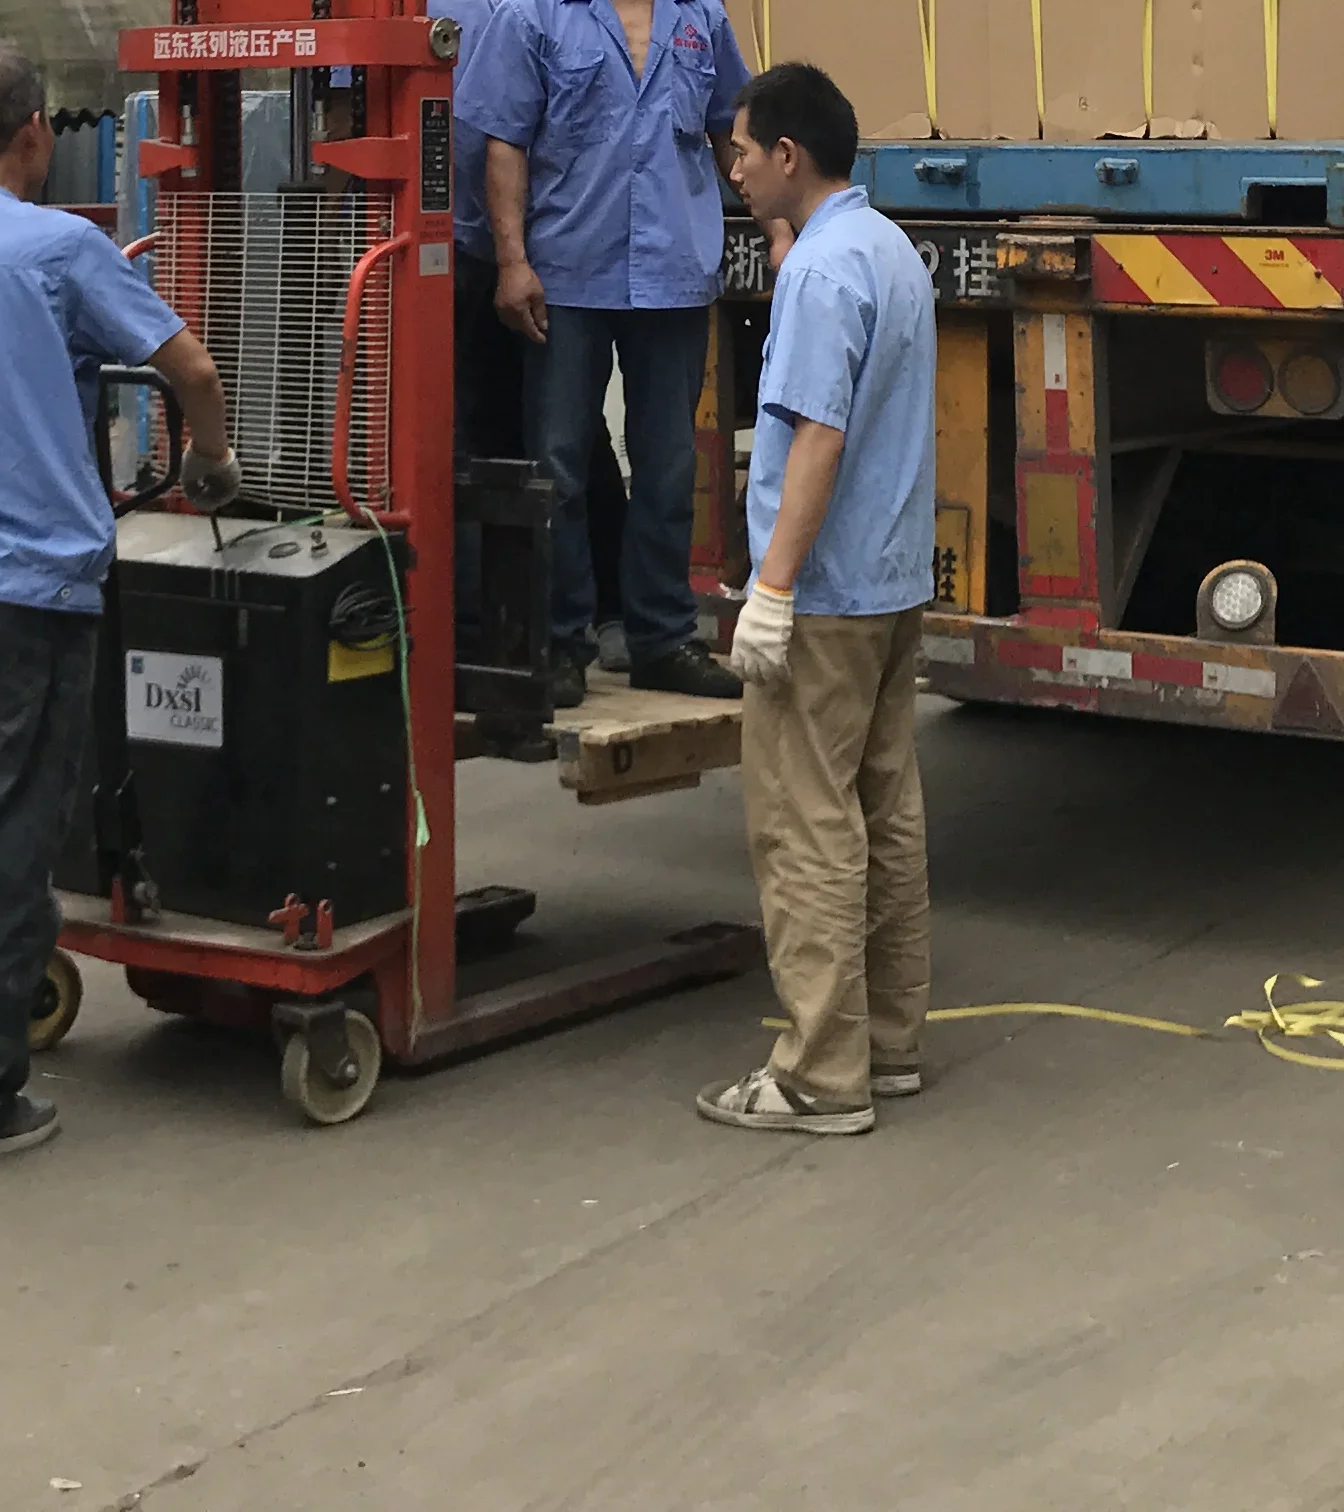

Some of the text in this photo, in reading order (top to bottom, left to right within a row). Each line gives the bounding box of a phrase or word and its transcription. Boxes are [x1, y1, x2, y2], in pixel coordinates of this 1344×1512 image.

[154, 28, 317, 59] 远东系列液压产品
[1264, 248, 1285, 261] 3M
